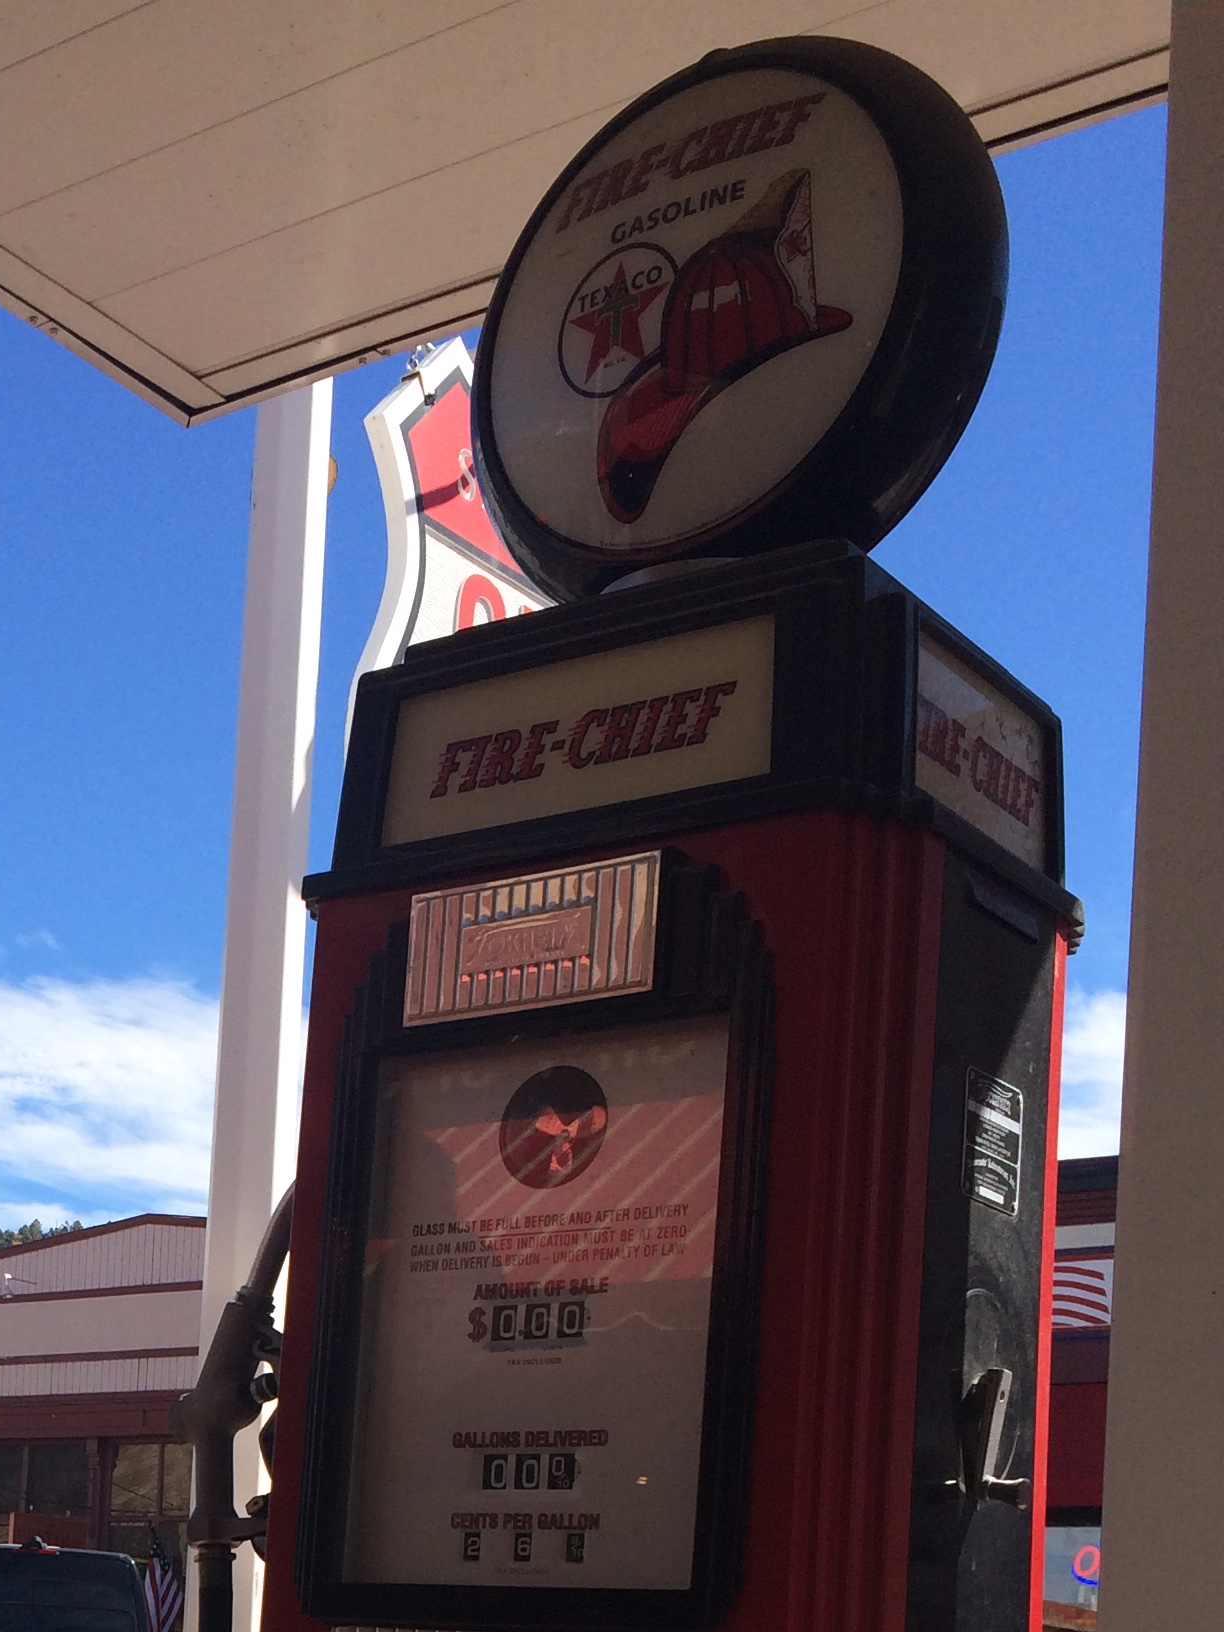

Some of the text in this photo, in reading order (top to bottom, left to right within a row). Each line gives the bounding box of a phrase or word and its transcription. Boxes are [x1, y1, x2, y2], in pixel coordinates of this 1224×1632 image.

[556, 92, 827, 234] FIRE-CHIEF
[611, 179, 746, 244] GASOLINE
[578, 265, 663, 313] TEXACO
[430, 681, 738, 799] FIRE-CHIEF
[917, 693, 1041, 827] IRE-CHIEF
[412, 1204, 689, 1237] GLASS MUST BE FULL BEFORE AND AFTER DELIVERY
[409, 1259, 438, 1273] WHEN
[441, 1255, 489, 1271] DELIVERY
[492, 1254, 502, 1268] IS
[504, 1251, 540, 1267] BEGUN
[552, 1248, 589, 1264] UNDER
[592, 1245, 640, 1260] PENALTY
[643, 1243, 658, 1257] OF
[661, 1241, 686, 1257] LAW
[410, 1241, 451, 1257] GALLON
[454, 1240, 476, 1254] AND
[479, 1237, 513, 1252] SALES
[516, 1233, 579, 1250] INDICATION
[583, 1230, 615, 1246] MUST
[620, 1229, 635, 1242] BE
[472, 1277, 609, 1301] AMOUNT OF SALE
[452, 1429, 609, 1449] GALLONS DELIVERED
[450, 1512, 601, 1530] CENTS PER GALLON
[466, 1536, 481, 1556] 2
[517, 1536, 531, 1556] 6
